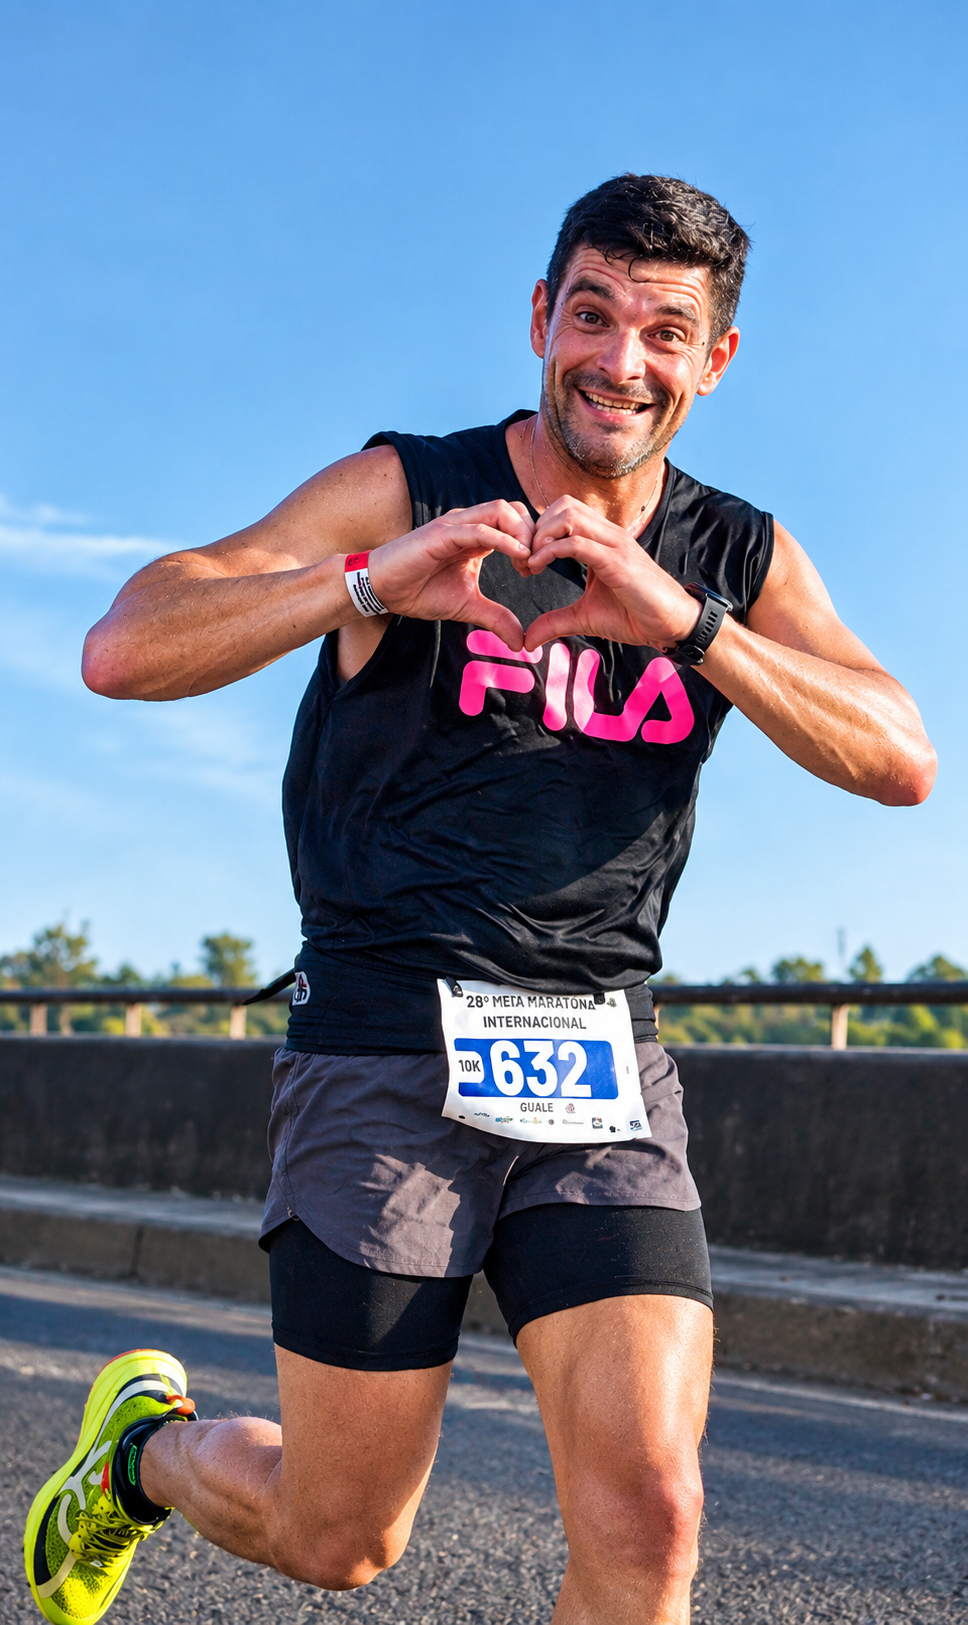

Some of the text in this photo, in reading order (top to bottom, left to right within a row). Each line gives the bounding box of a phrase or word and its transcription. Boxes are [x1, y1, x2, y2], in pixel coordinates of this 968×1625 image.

[459, 629, 695, 744] FILA
[483, 1016, 587, 1030] INTERNACIONAL
[458, 1059, 481, 1072] 10K
[490, 1040, 591, 1097] 632
[520, 1102, 554, 1113] GUALE
